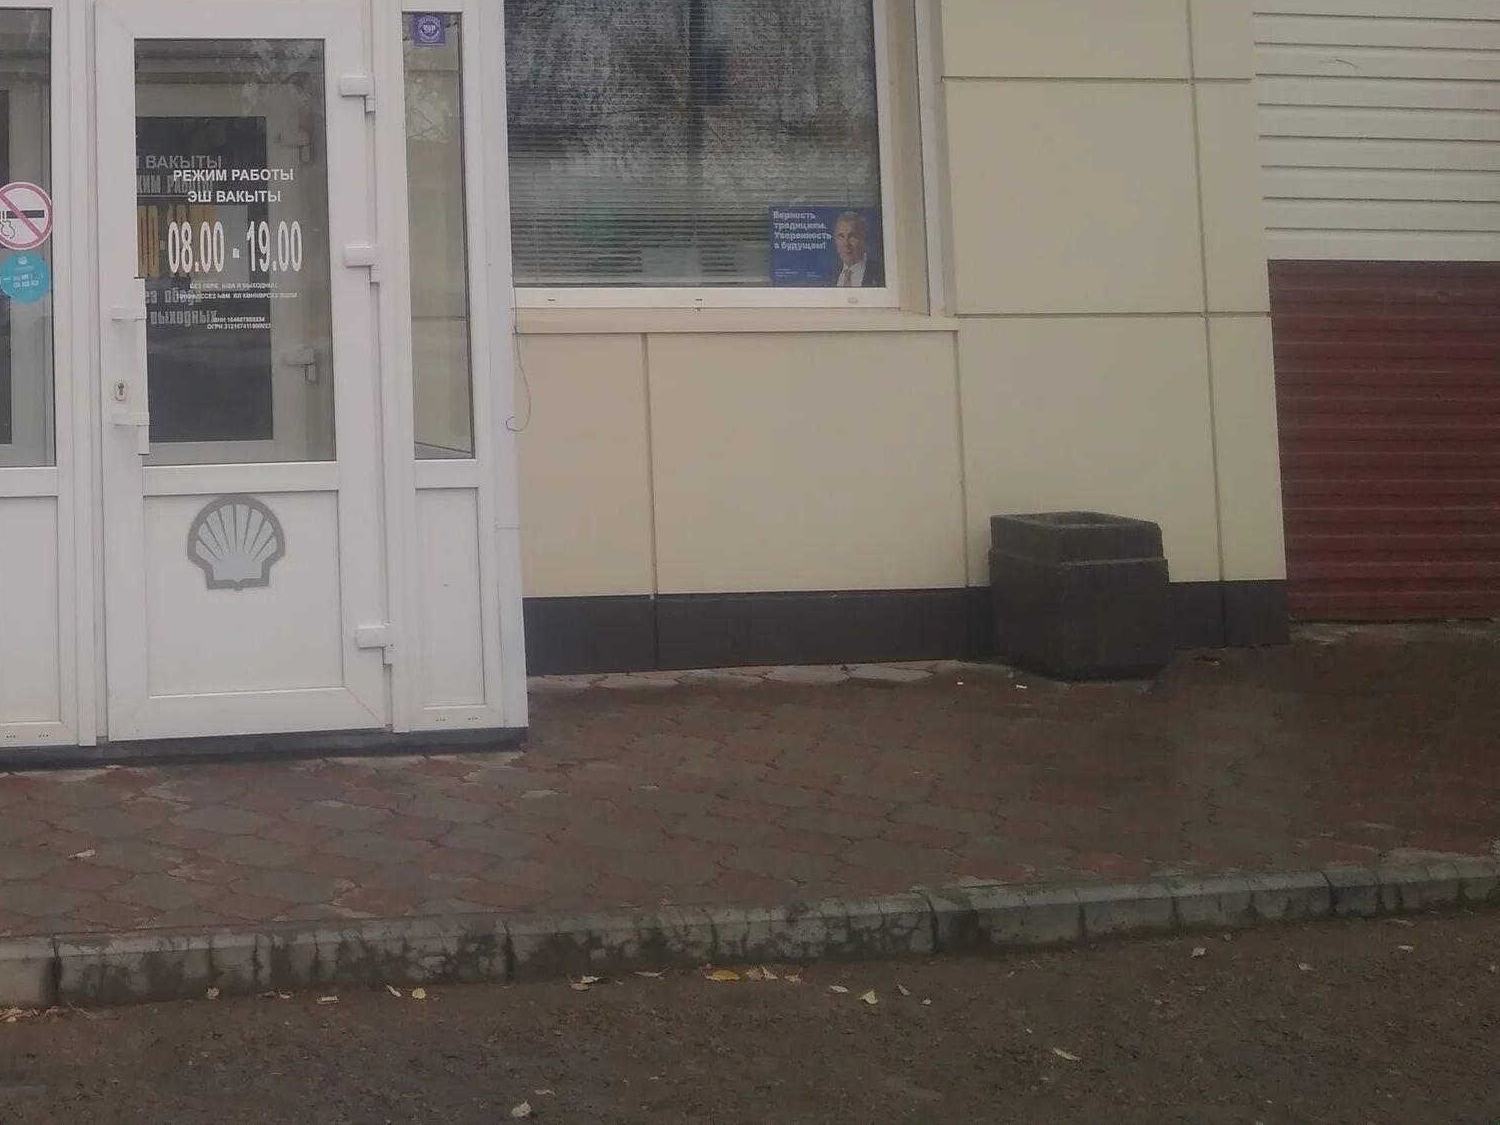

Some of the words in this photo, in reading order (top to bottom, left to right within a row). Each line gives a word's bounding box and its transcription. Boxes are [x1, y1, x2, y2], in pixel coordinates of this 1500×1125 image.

[145, 155, 222, 169] ВАКЫТЫ
[173, 169, 228, 182] РЕЖИМ
[231, 168, 294, 181] РАБОТЫ
[187, 190, 212, 203] ЭШ
[216, 190, 282, 203] ВАКЫТЫ
[773, 210, 816, 220] Верность
[774, 231, 832, 240] Уверенность
[167, 220, 225, 274] 08.00
[246, 220, 303, 273] 19.00
[781, 241, 826, 251] будущем!
